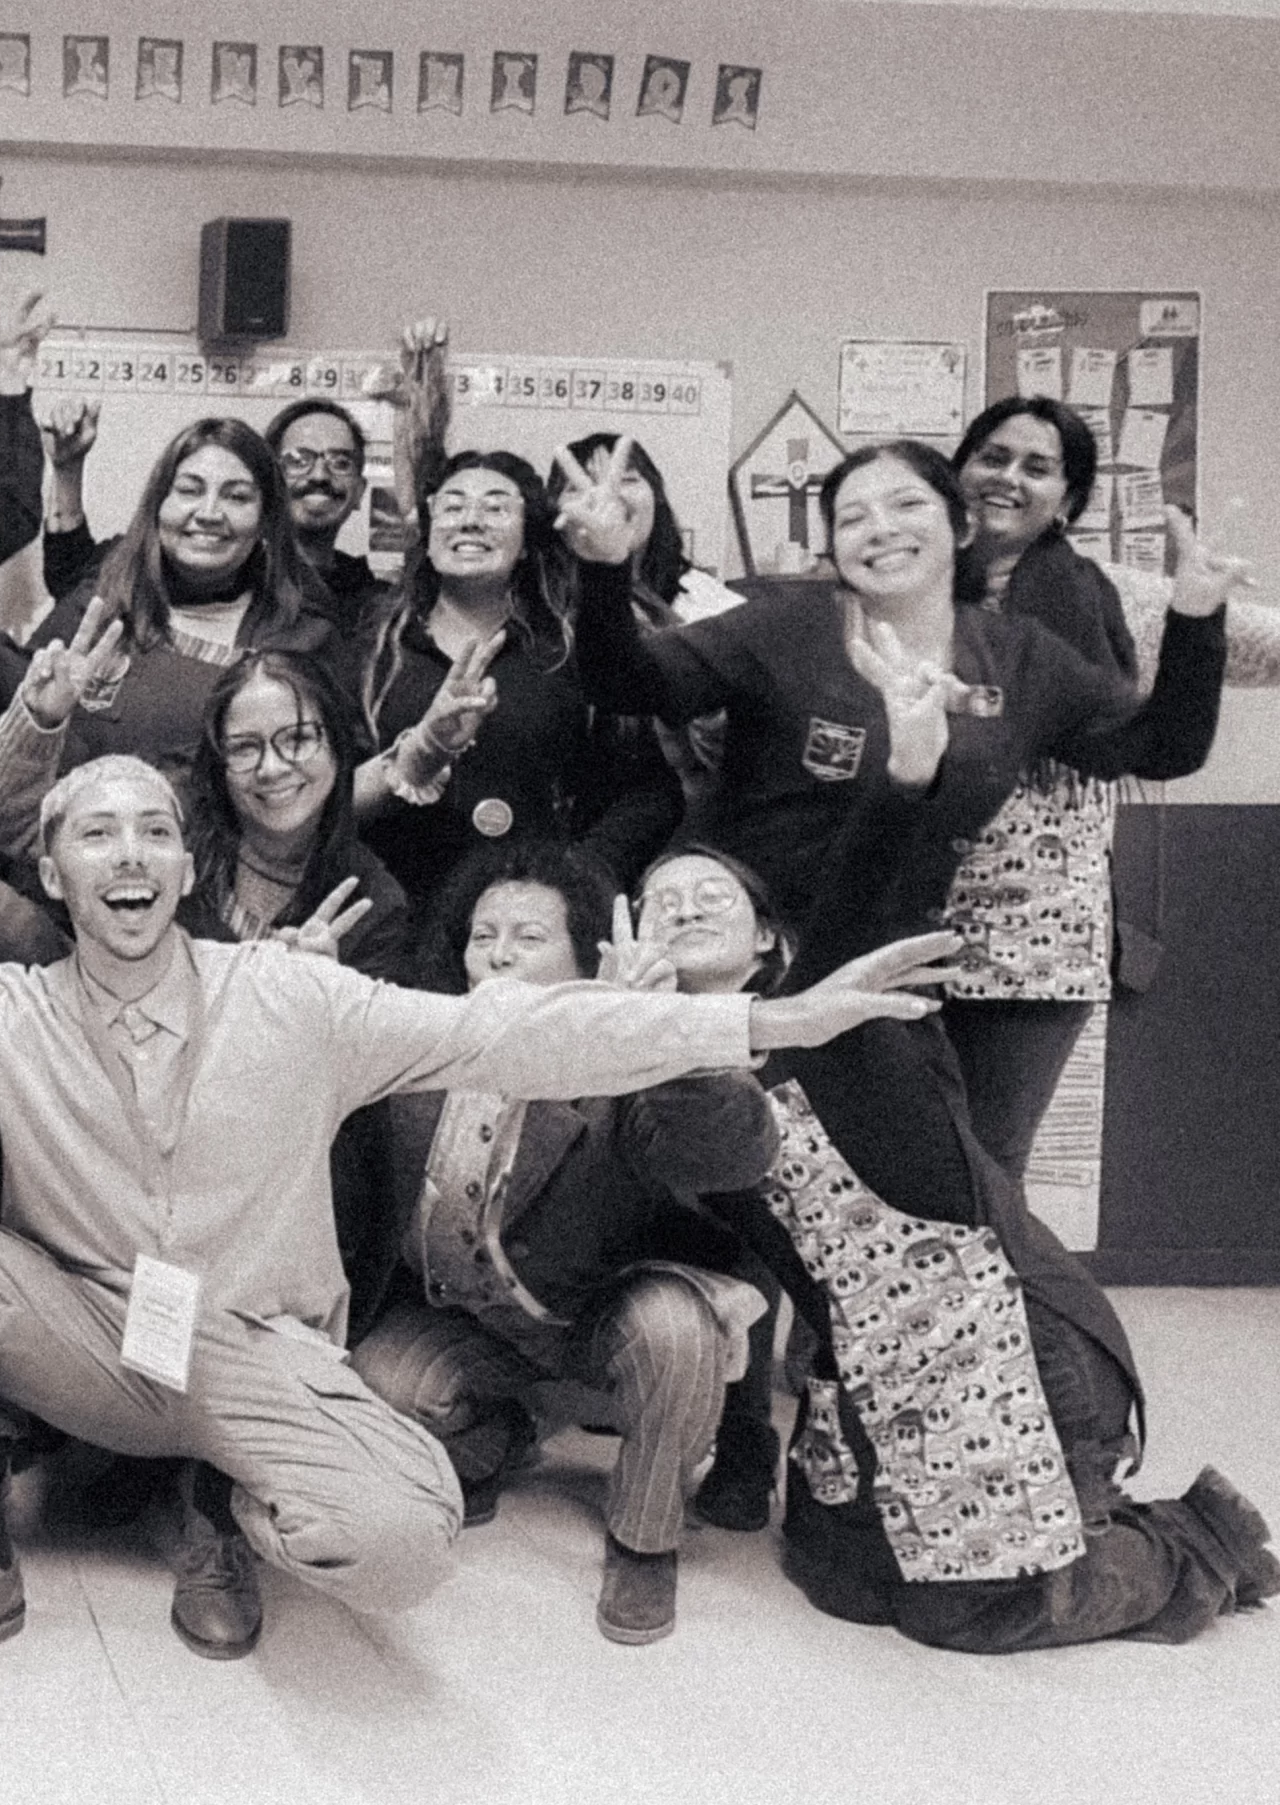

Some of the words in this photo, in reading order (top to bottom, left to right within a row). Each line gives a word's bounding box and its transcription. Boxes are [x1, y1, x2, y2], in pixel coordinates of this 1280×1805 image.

[40, 360, 65, 379] 21
[74, 361, 101, 380] 22
[106, 362, 134, 382] 23
[141, 363, 168, 382] 24
[177, 363, 204, 383] 25
[210, 364, 237, 384] 26
[509, 376, 535, 396] 35
[542, 379, 568, 398] 36
[575, 380, 601, 399] 37
[606, 381, 634, 401] 38
[641, 383, 666, 402] 39
[672, 385, 697, 404] 40
